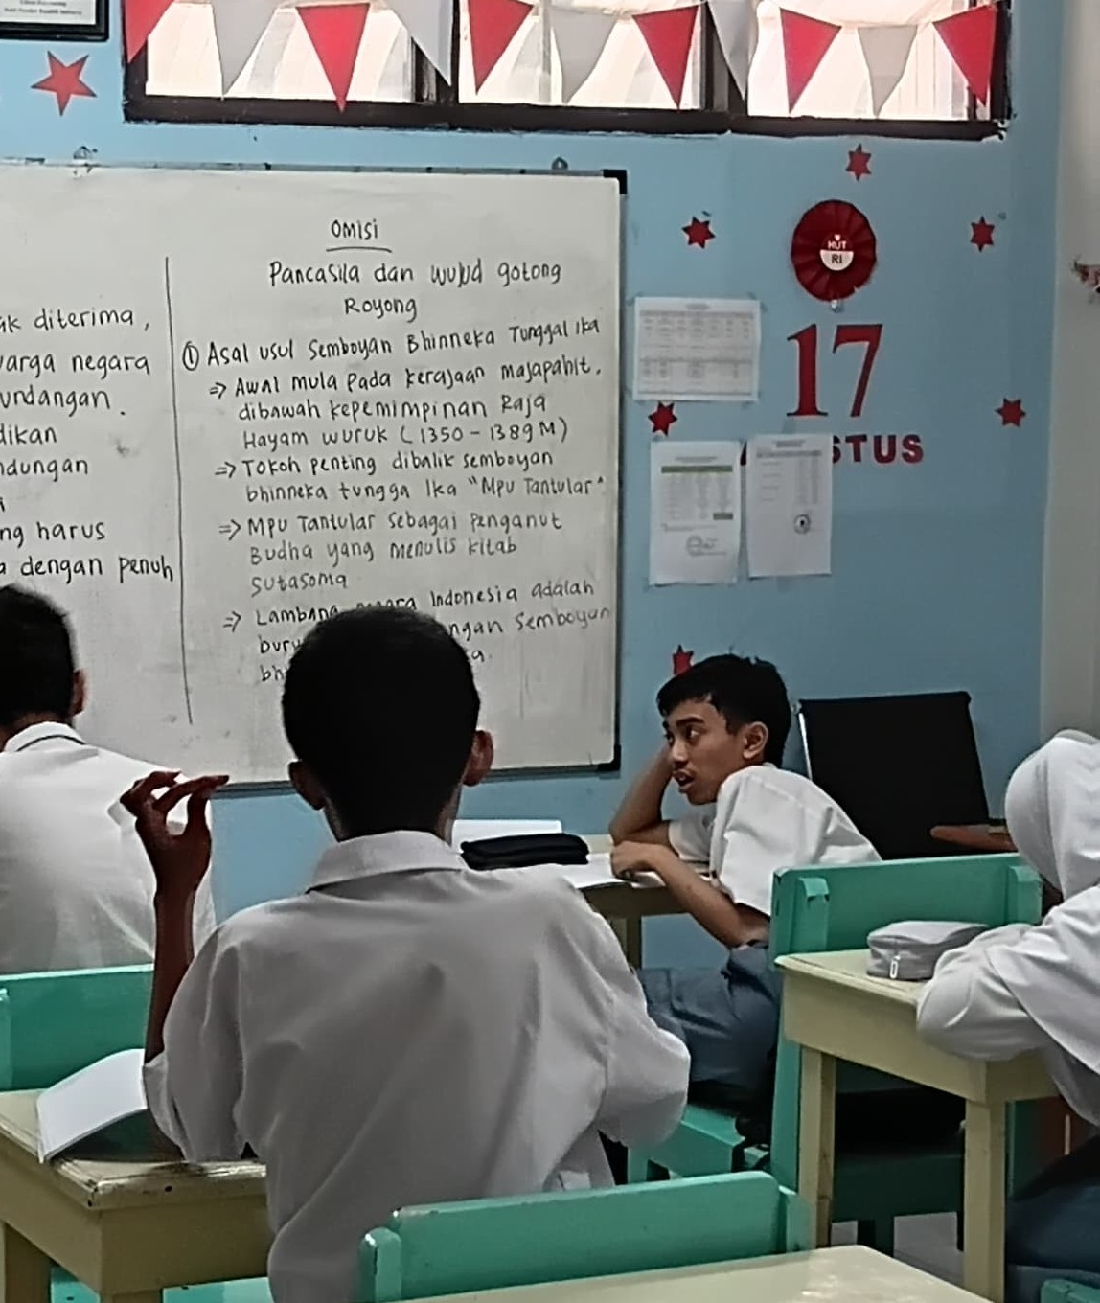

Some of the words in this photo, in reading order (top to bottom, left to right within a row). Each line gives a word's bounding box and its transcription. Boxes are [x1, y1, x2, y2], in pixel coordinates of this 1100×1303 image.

[269, 260, 360, 287] Pancasila
[374, 261, 414, 282] dan
[497, 260, 562, 288] gotong
[344, 297, 418, 323] Royong
[207, 341, 249, 366] Asal
[260, 338, 294, 360] usul
[407, 329, 495, 354] Bhinneka
[72, 354, 150, 379] negara
[787, 323, 883, 418] 17
[235, 376, 280, 398] Awal
[291, 372, 338, 392] mula
[239, 399, 321, 422] dibawah
[243, 430, 309, 452] Hayam
[241, 455, 301, 477] Tokoh
[310, 454, 377, 476] penting
[36, 521, 106, 541] harus
[297, 513, 376, 533] Tantular
[250, 539, 314, 566] Budha
[327, 542, 375, 568] yang
[20, 557, 104, 585] dengan
[119, 555, 174, 584] penuh
[430, 585, 518, 608] Indonesia
[532, 579, 595, 599] adalah
[448, 622, 504, 642] ngan
